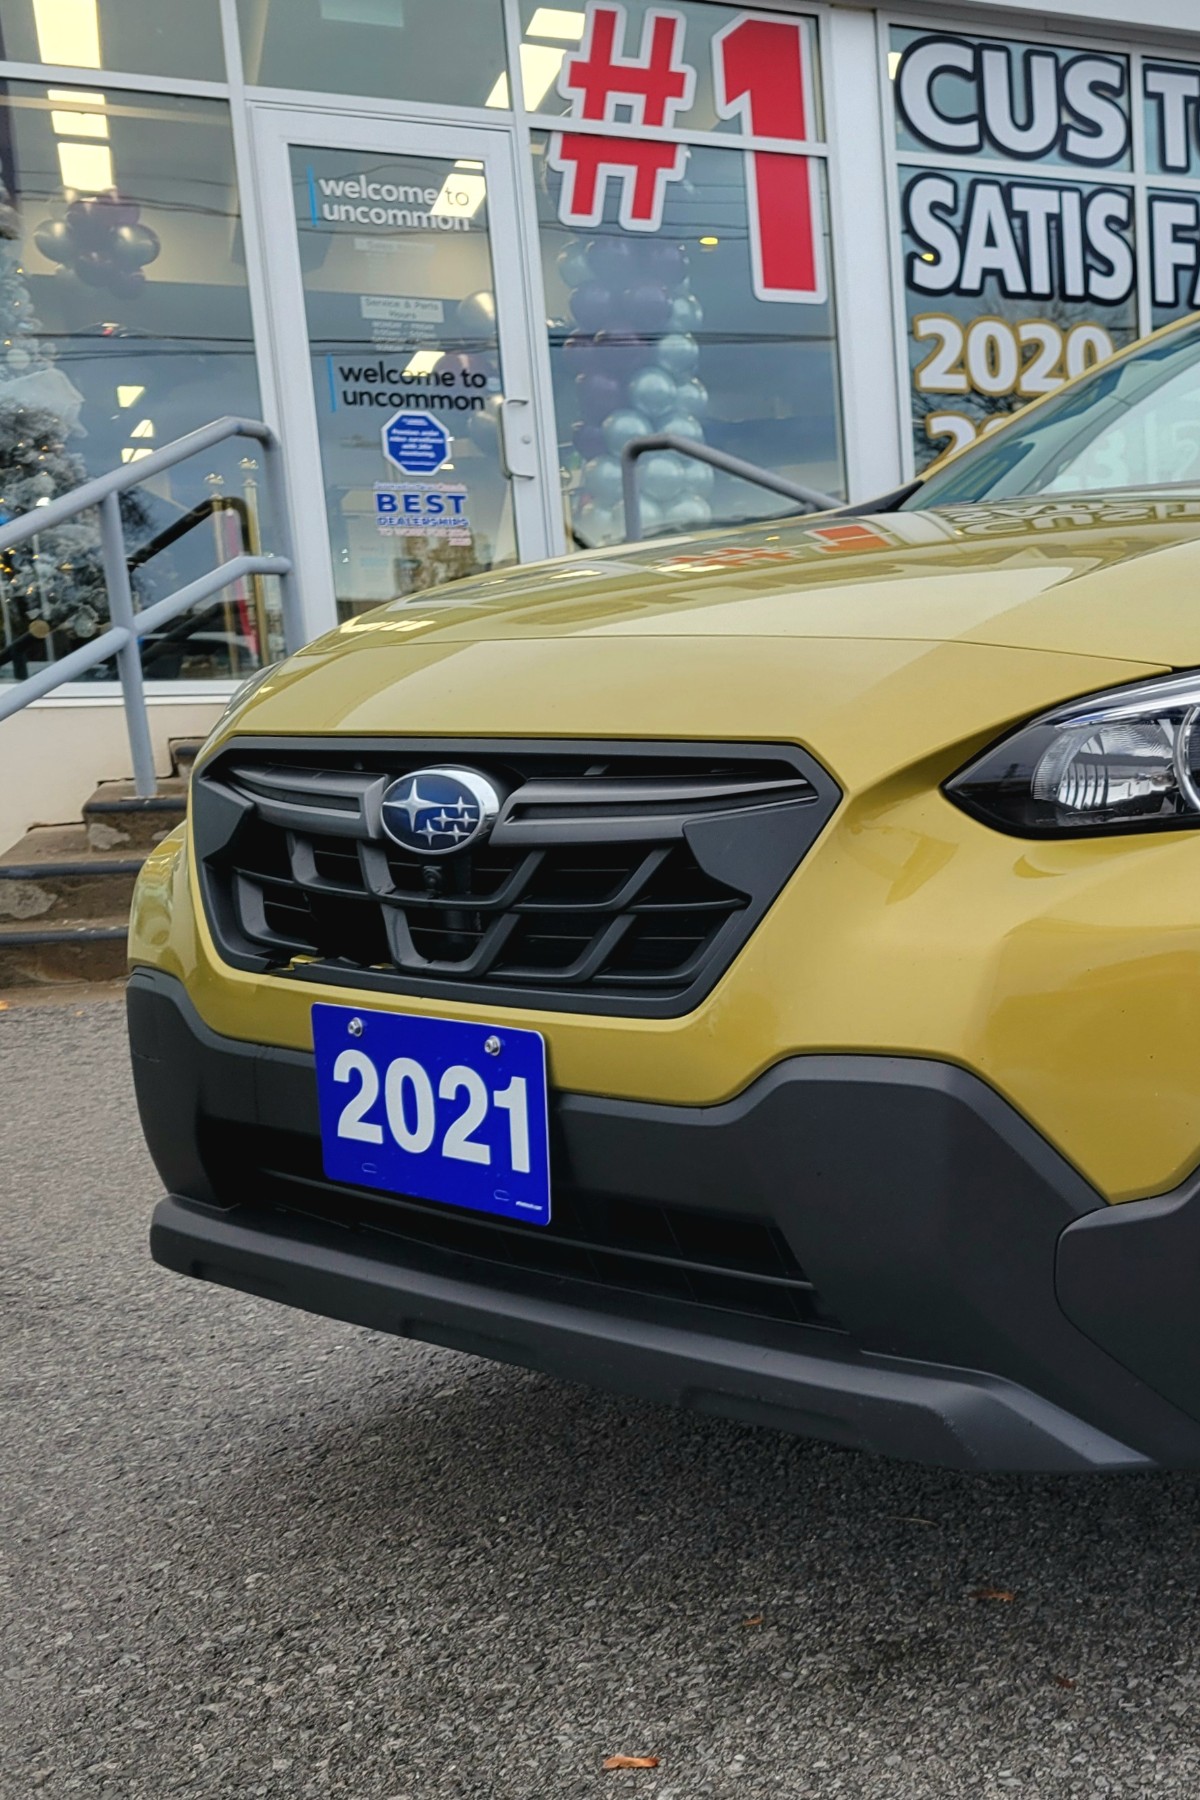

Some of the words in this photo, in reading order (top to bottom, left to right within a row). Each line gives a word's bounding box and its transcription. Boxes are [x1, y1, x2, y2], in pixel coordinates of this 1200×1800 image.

[318, 175, 439, 205] welcome
[444, 186, 470, 206] to
[322, 202, 470, 231] uncommon
[913, 312, 1115, 396] 2020
[339, 361, 455, 387] welcome
[461, 369, 487, 388] to
[342, 389, 485, 410] uncommon
[376, 492, 467, 515] BEST
[333, 1049, 530, 1174] 2021
